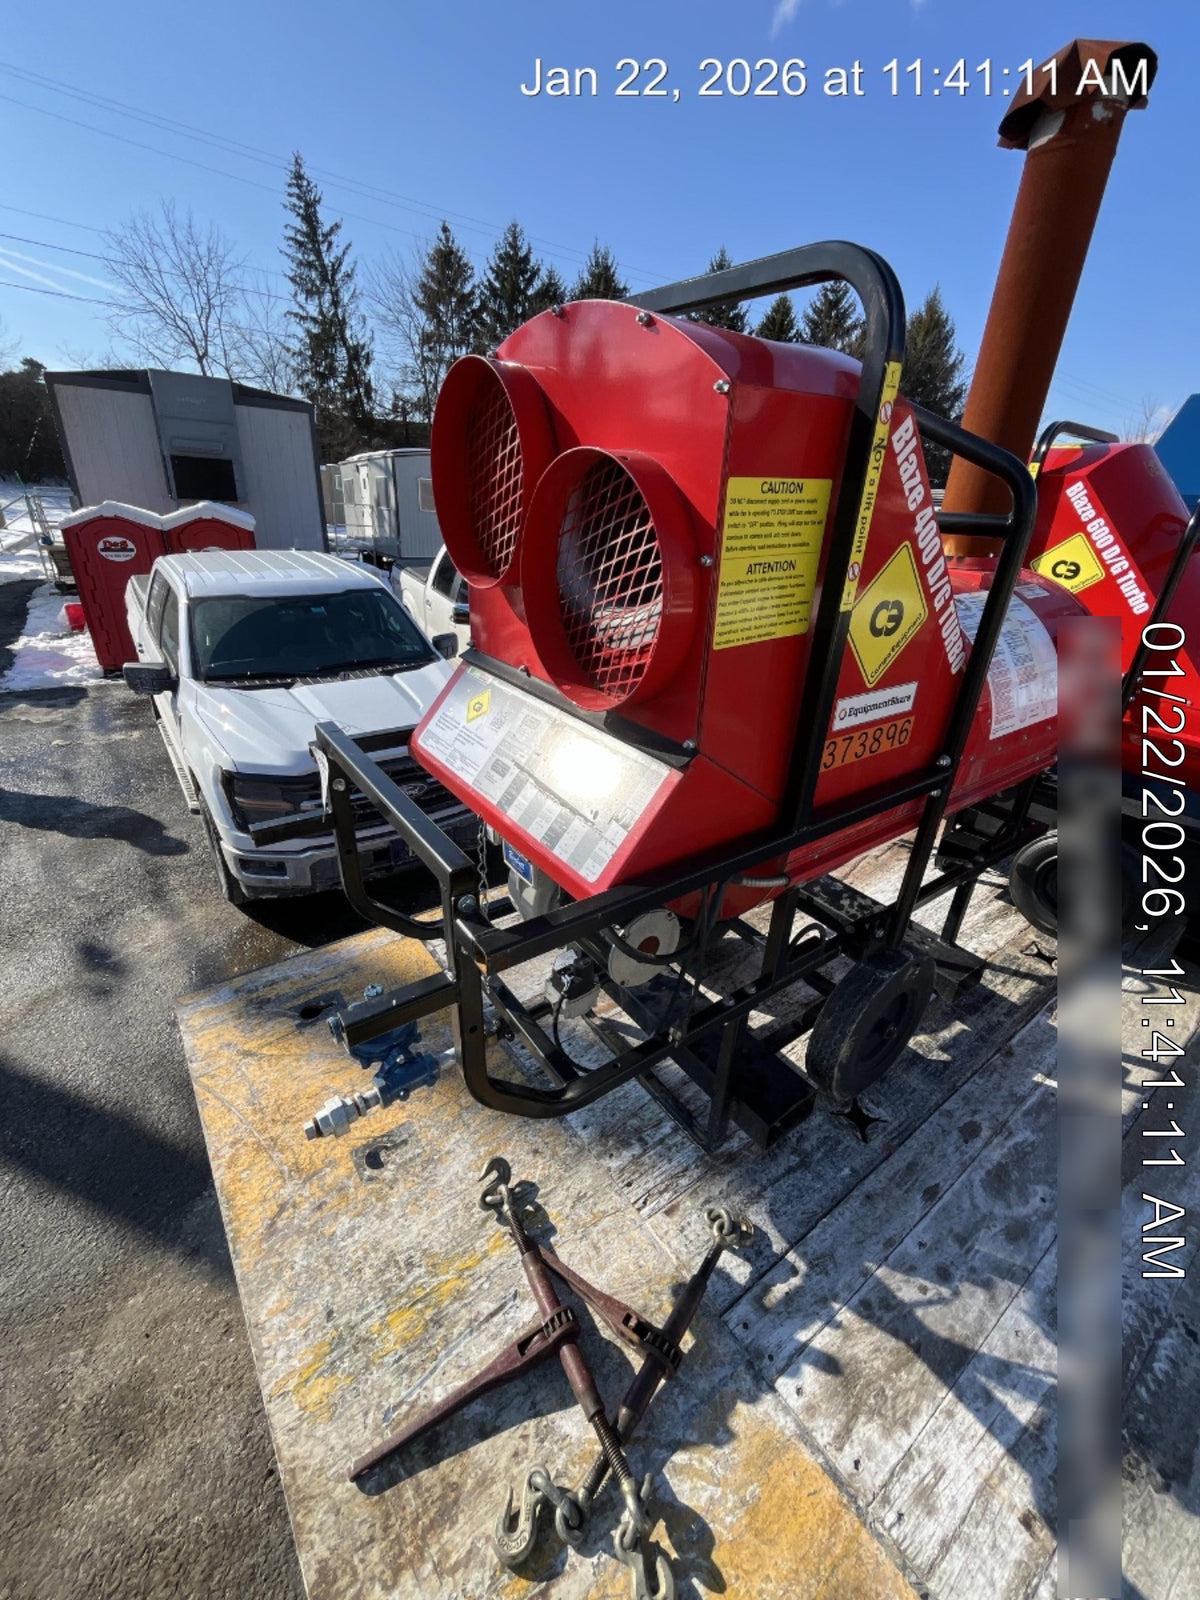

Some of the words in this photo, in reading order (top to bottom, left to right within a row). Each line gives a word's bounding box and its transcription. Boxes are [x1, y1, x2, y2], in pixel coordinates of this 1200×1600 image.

[873, 437, 887, 473] NOT
[892, 414, 924, 511] Blaze
[760, 481, 804, 495] CAUTION
[862, 494, 874, 512] lift
[854, 515, 867, 554] point
[914, 505, 940, 565] 400
[1065, 481, 1096, 522] Blaze
[1087, 517, 1115, 550] 600
[1101, 544, 1129, 576] D/G
[1116, 570, 1150, 616] Turbo
[746, 560, 797, 577] ATTENTION
[926, 555, 952, 612] D/G
[891, 612, 923, 653] Equipment
[938, 598, 967, 676] TURBO
[848, 695, 912, 717] EquipmentShare
[823, 719, 912, 769] 373896
